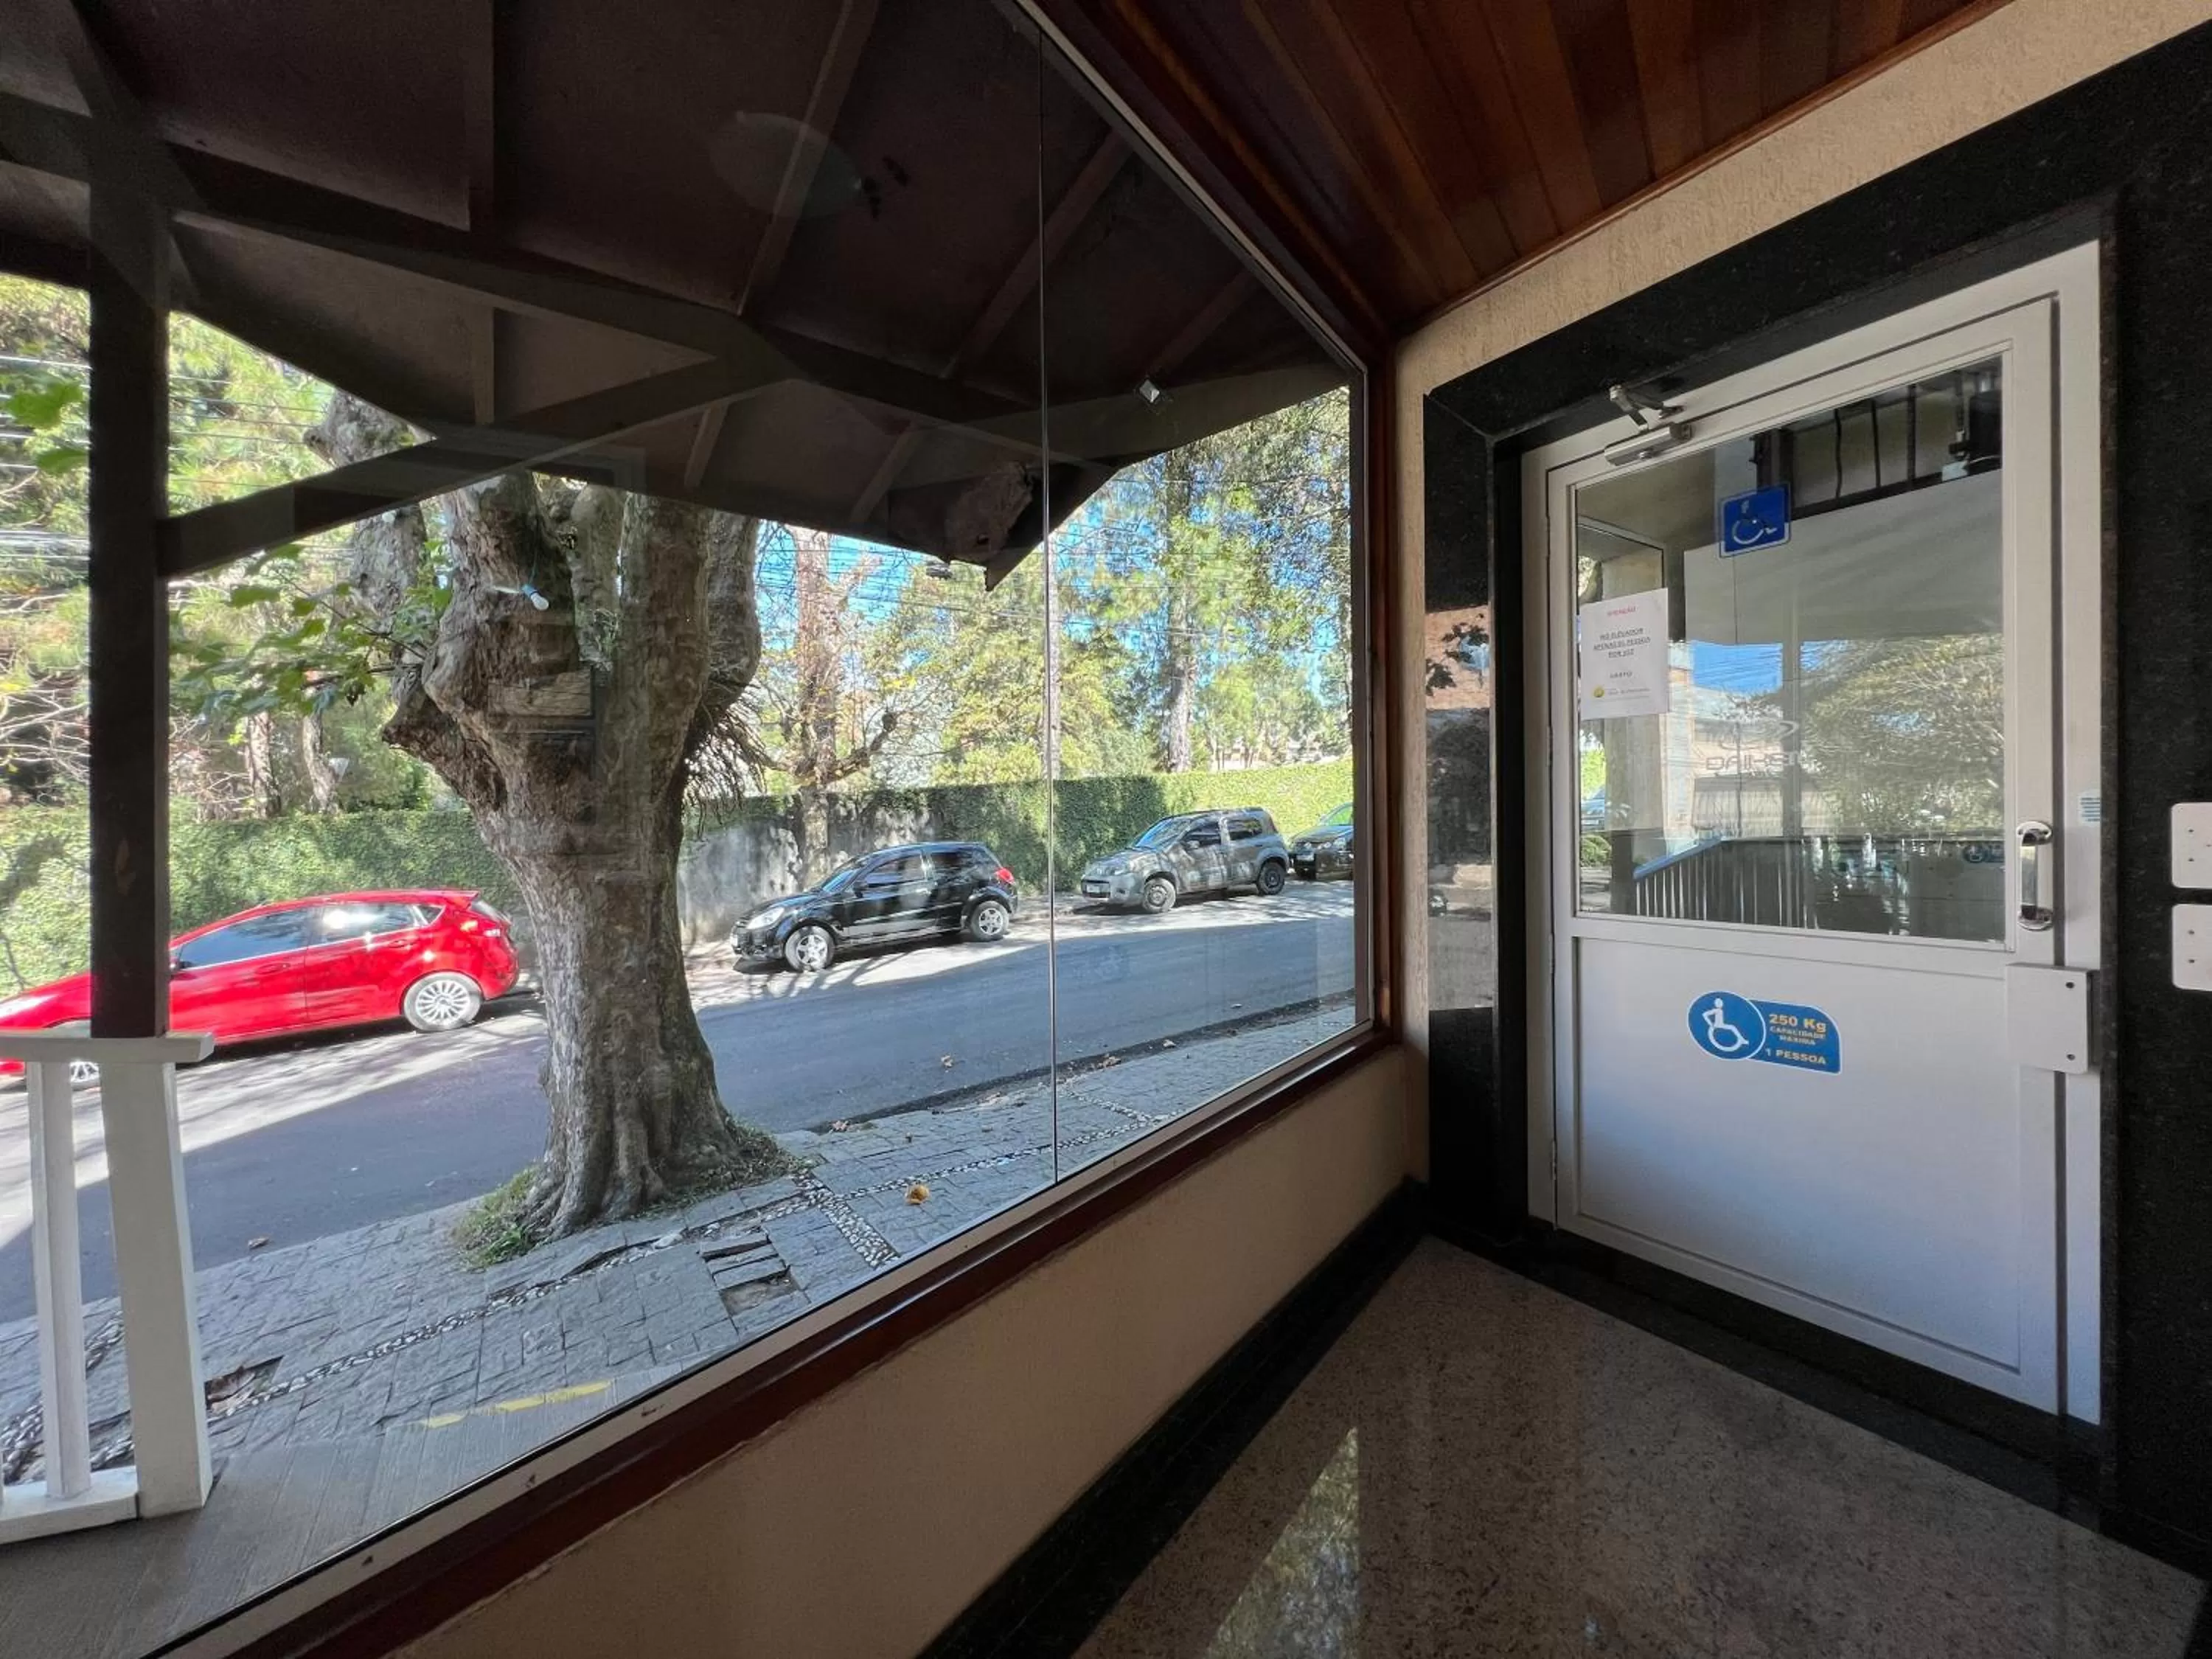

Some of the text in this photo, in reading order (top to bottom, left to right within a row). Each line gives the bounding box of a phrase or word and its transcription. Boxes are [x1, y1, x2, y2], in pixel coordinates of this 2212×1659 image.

[1770, 1014, 1826, 1033] 250 Kg
[1766, 1048, 1826, 1065] 1 PESSOA
